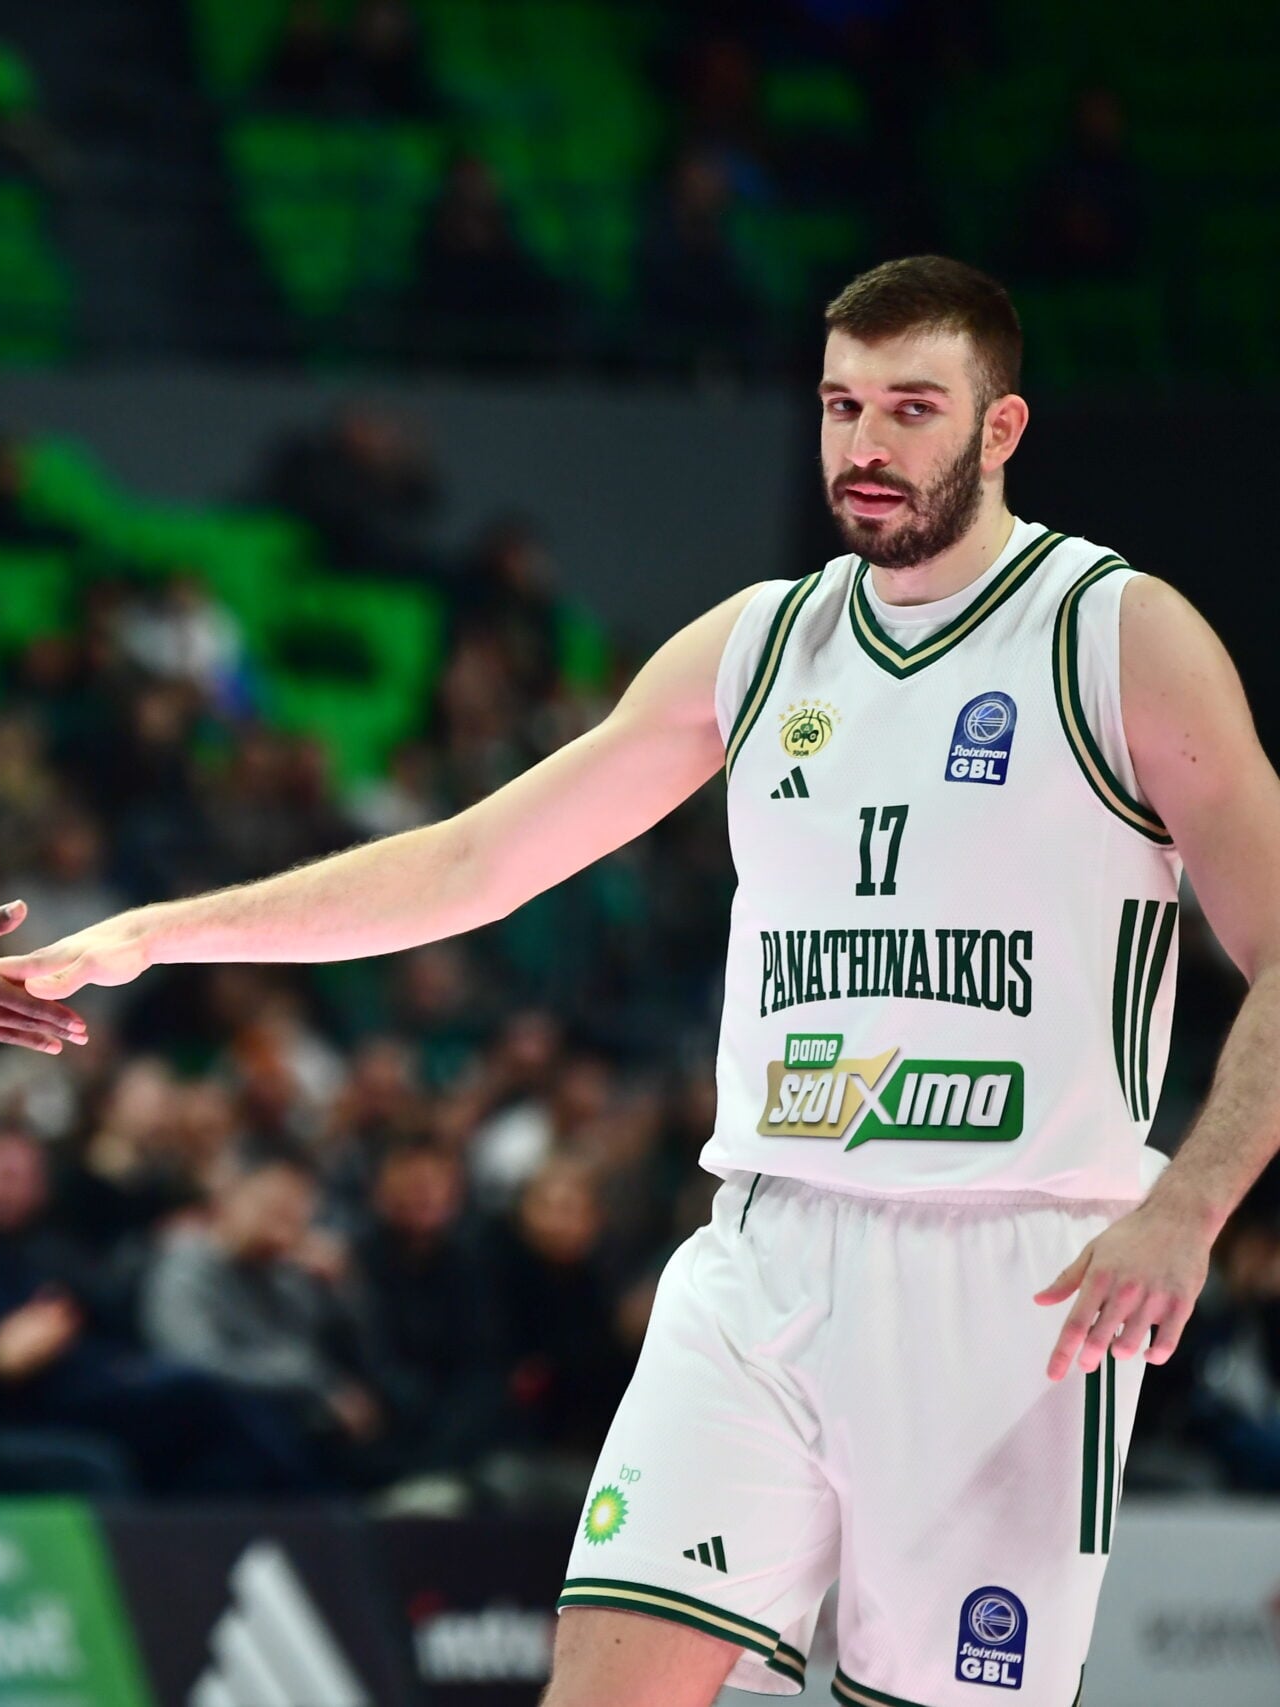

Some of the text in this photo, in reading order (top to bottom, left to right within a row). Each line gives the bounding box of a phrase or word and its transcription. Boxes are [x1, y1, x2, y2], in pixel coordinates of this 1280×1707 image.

[951, 744, 1008, 759] Stoiximan
[950, 759, 1002, 780] GBL
[855, 804, 910, 896] 17
[759, 928, 1033, 1019] PANATHINAIKOS
[788, 1038, 838, 1065] pame
[619, 1463, 641, 1484] bp
[959, 1642, 1022, 1663] Stoiximan
[960, 1657, 1017, 1686] GBL
